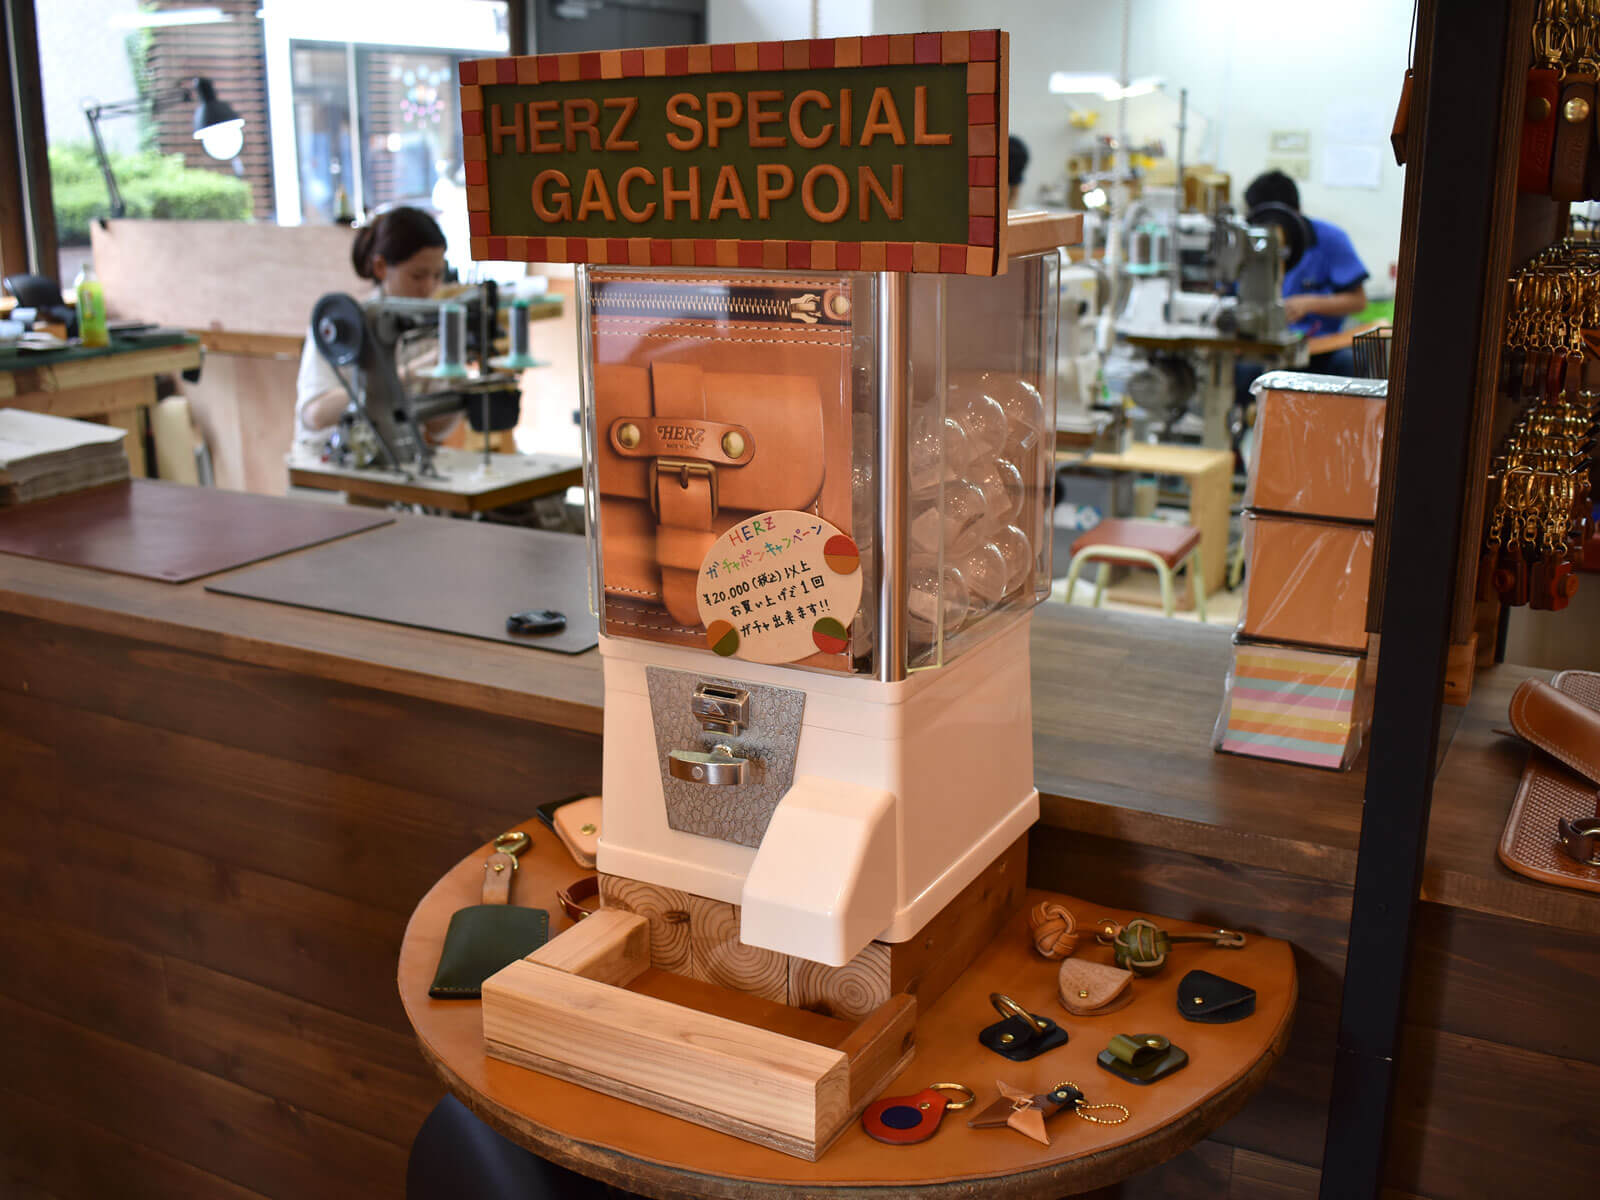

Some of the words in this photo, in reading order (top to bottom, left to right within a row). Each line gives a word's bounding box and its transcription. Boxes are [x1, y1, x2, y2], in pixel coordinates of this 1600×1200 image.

[491, 98, 640, 154] HERZ
[665, 85, 952, 151] SPECIAL
[531, 163, 904, 224] GACHAPON
[657, 425, 705, 446] HERZ
[728, 516, 776, 546] HERZ
